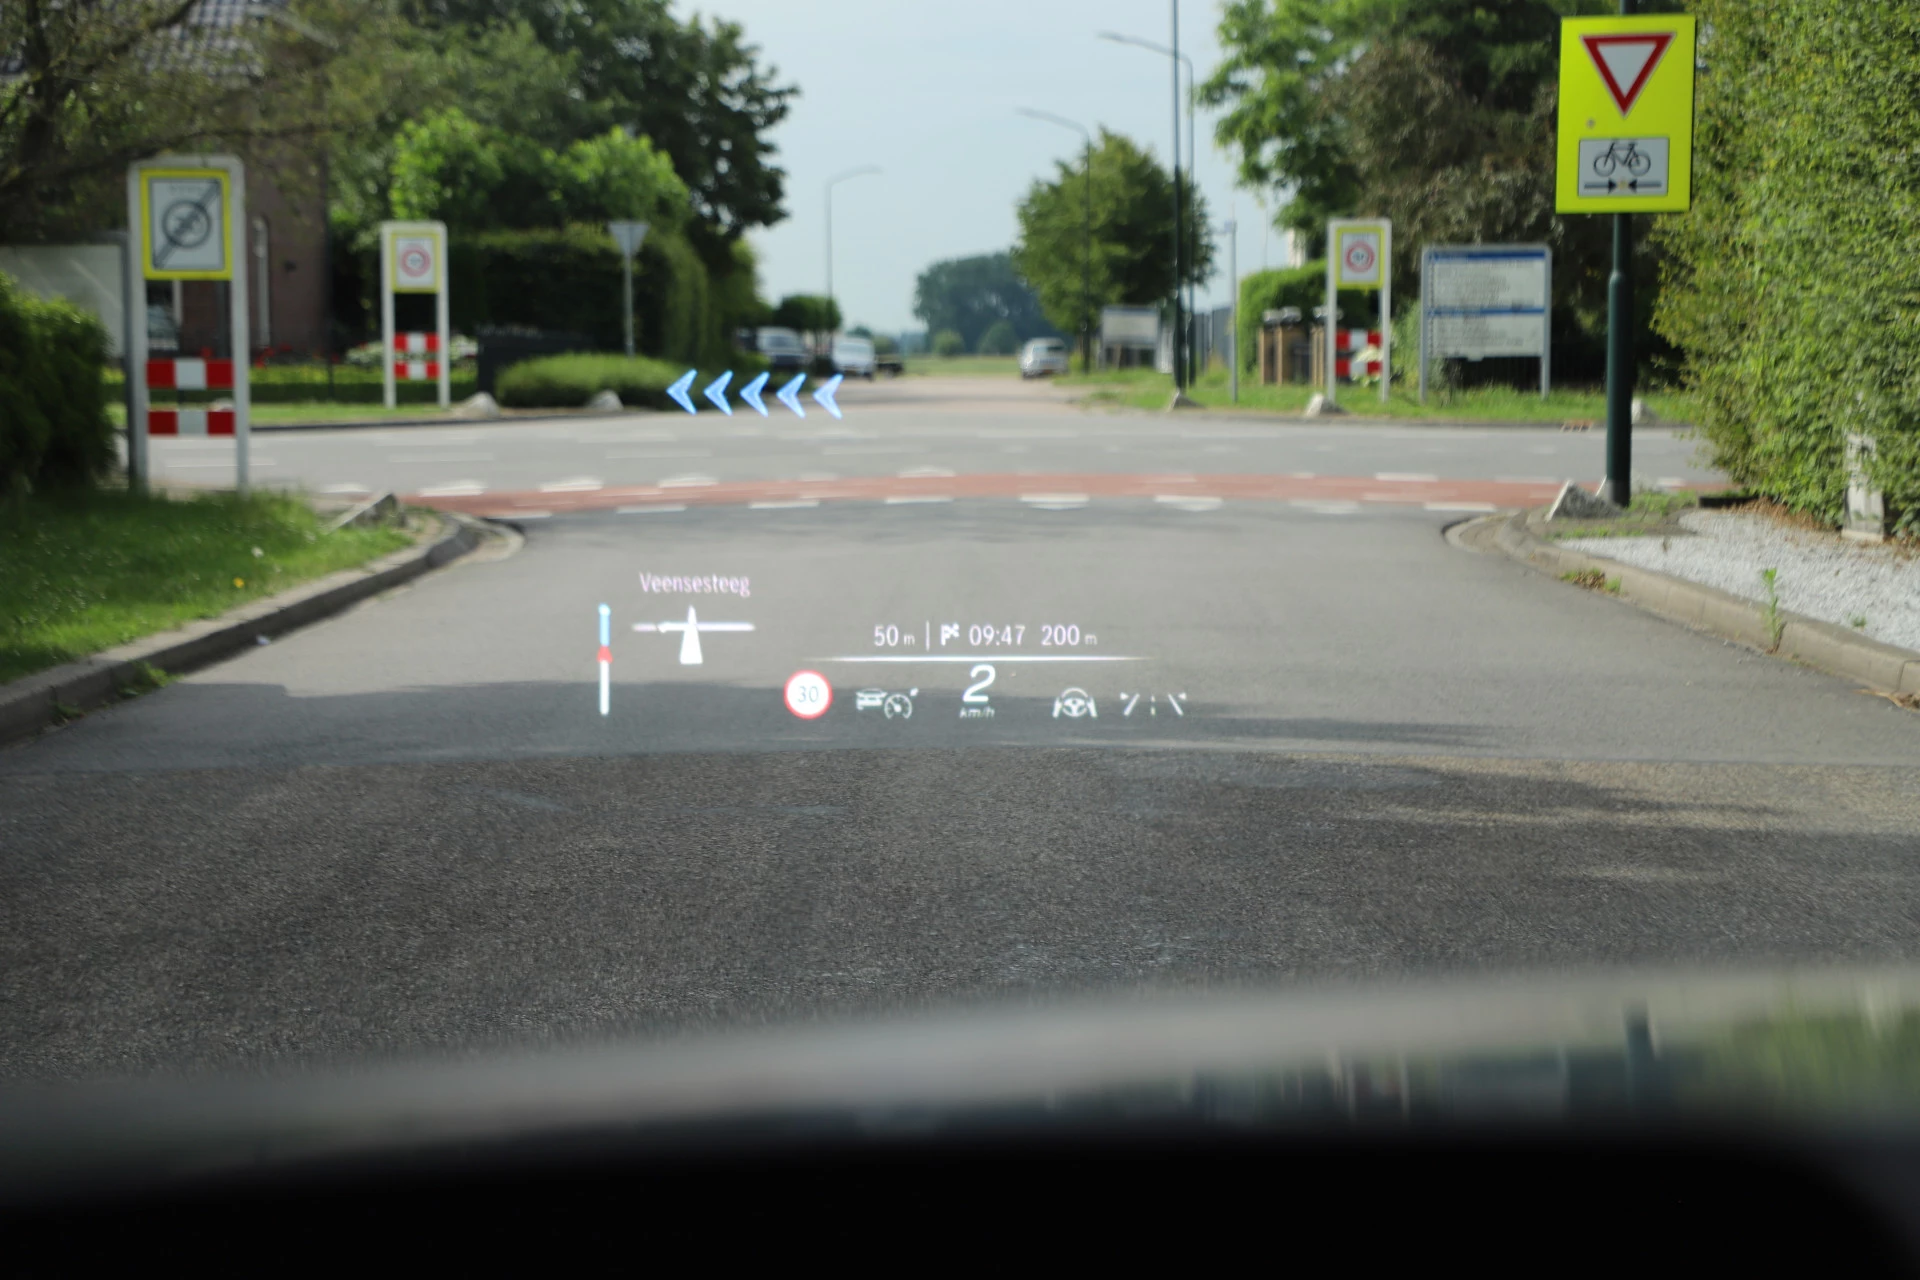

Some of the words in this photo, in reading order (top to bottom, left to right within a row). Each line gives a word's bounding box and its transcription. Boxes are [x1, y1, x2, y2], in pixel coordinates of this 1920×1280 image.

[639, 572, 751, 598] Veensesteeg
[873, 624, 899, 647] 50
[968, 623, 1026, 647] 09:47
[1040, 623, 1081, 647] 200
[797, 685, 820, 704] 30
[962, 664, 996, 703] 2
[958, 705, 996, 719] km/h
